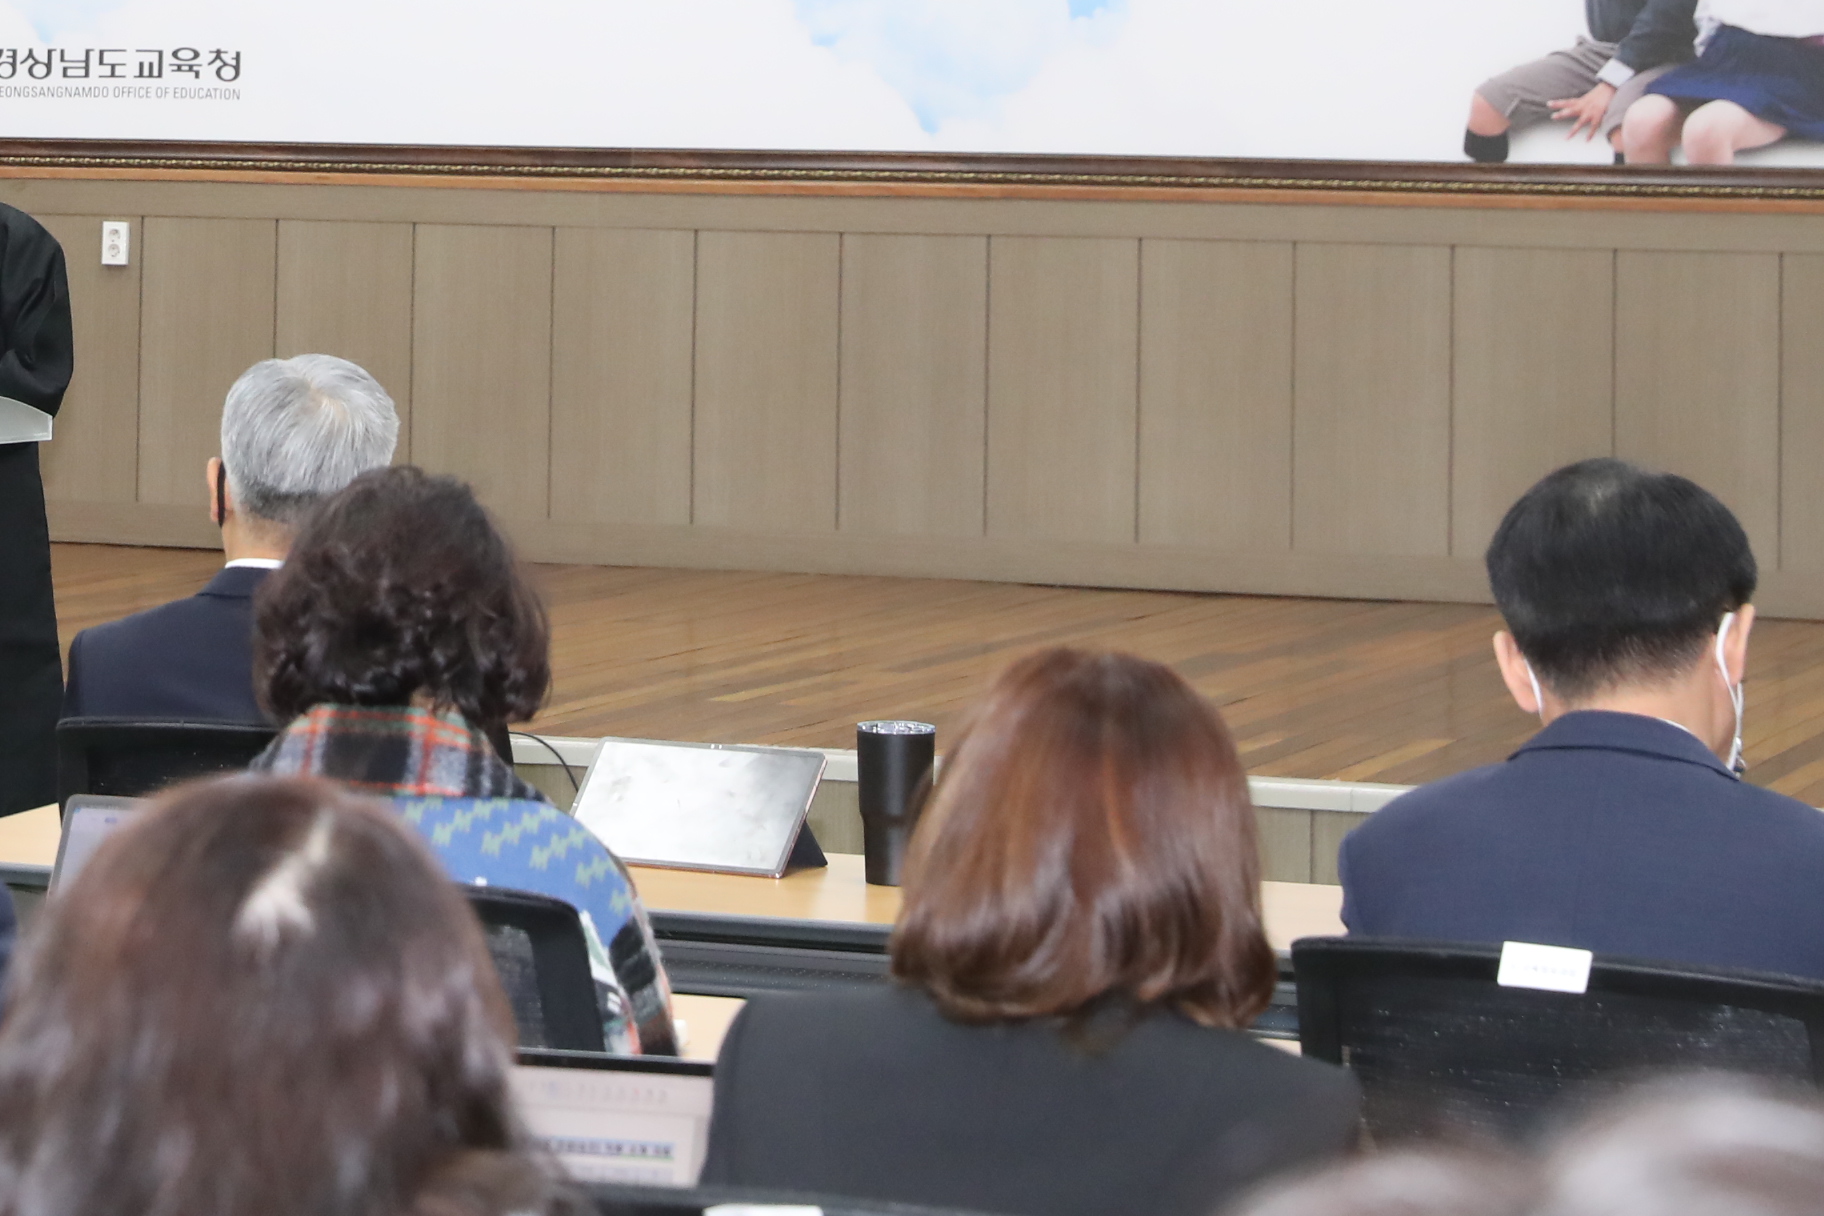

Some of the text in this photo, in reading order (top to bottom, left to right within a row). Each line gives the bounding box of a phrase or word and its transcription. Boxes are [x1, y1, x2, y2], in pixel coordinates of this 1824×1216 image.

[113, 85, 152, 99] OFFICE
[155, 85, 171, 99] OF
[173, 86, 242, 101] EDUCATION
